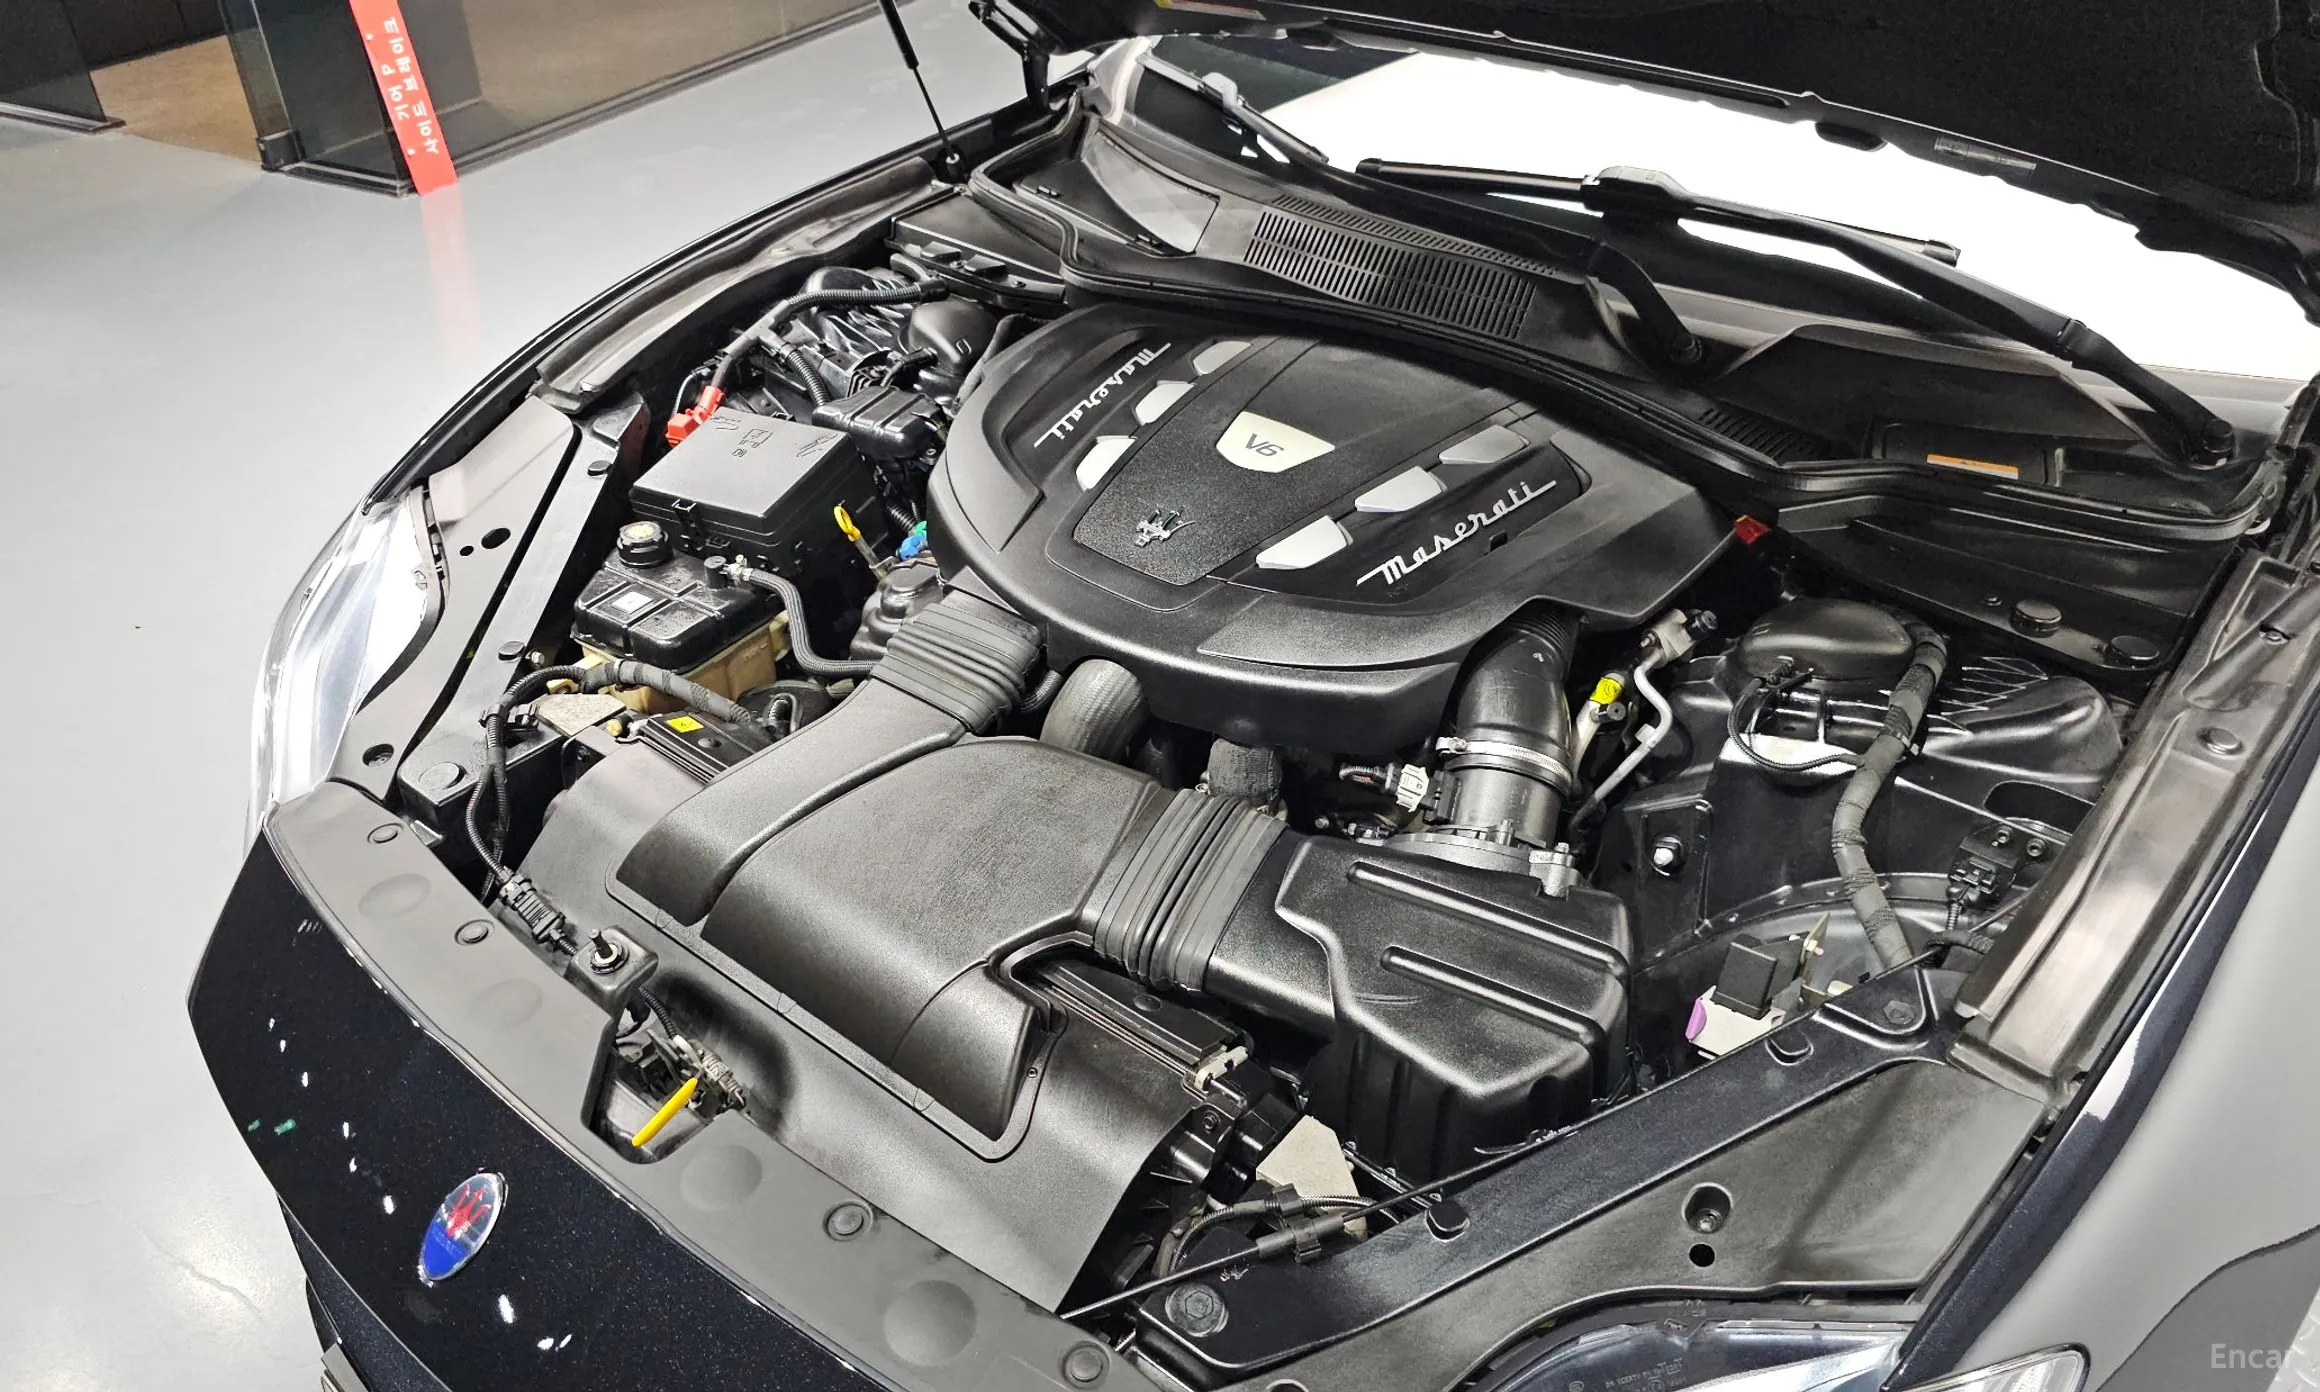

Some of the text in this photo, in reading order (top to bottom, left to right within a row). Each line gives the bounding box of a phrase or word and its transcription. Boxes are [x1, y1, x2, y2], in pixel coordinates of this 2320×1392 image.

[381, 64, 410, 121] 기어 P
[384, 16, 439, 155] 사이드 브레이크
[1033, 342, 1172, 448] Maserati
[1245, 433, 1284, 457] V6
[1355, 480, 1557, 587] Maserati
